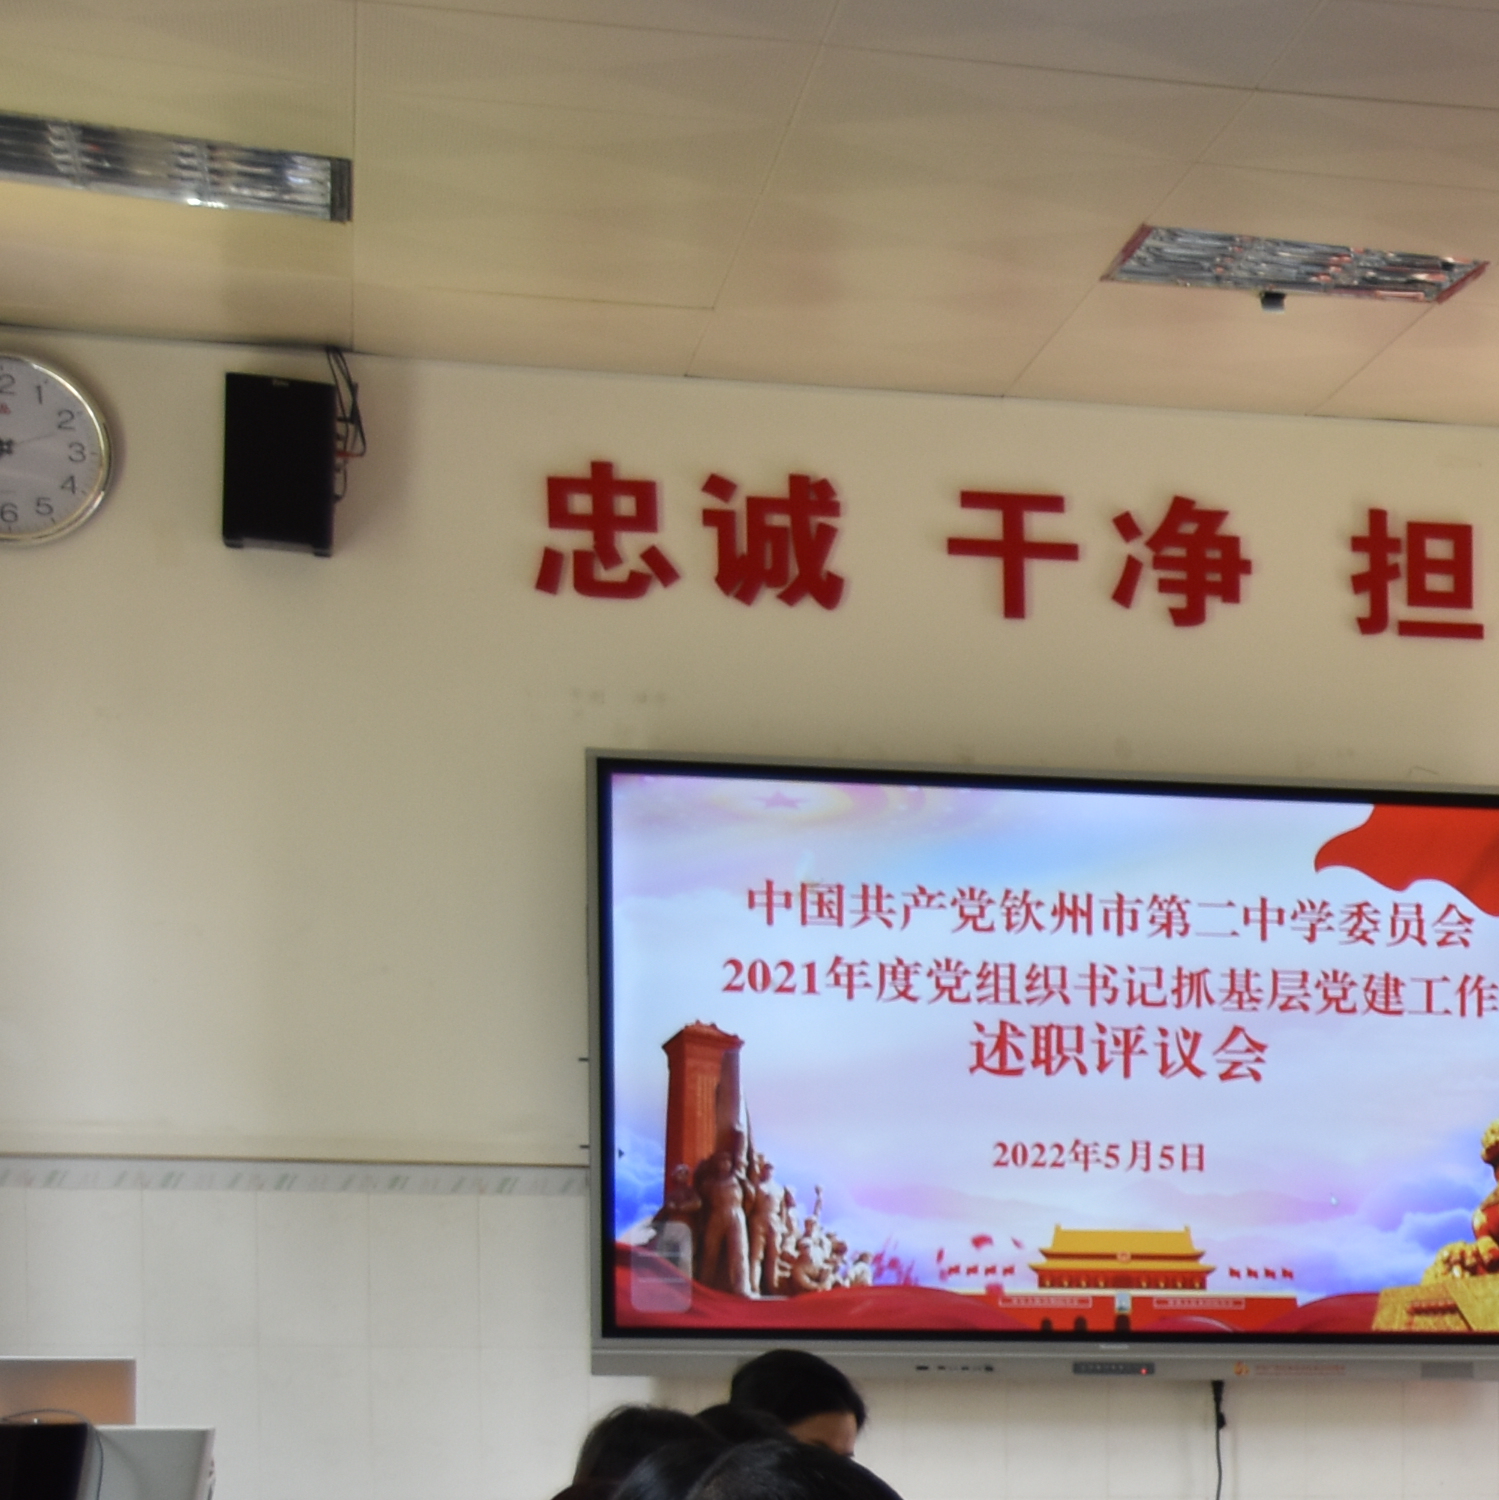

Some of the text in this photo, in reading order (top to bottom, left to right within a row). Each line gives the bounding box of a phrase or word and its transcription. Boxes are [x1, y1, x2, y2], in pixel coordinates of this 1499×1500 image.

[35, 384, 43, 404] 1
[57, 408, 76, 430] 2
[68, 441, 87, 463] 3
[60, 474, 77, 494] 4
[0, 502, 18, 523] 6
[35, 496, 54, 516] 5
[535, 460, 846, 611] 忠诚
[946, 489, 1254, 628] 干净
[745, 878, 1477, 951] 中国共产党钦州市第二中学委员会
[721, 955, 1499, 1021] 2021年度党组织书记抓基层党建工作
[968, 1021, 1269, 1083] 述职评议会
[992, 1138, 1206, 1174] 2022年5月5日
